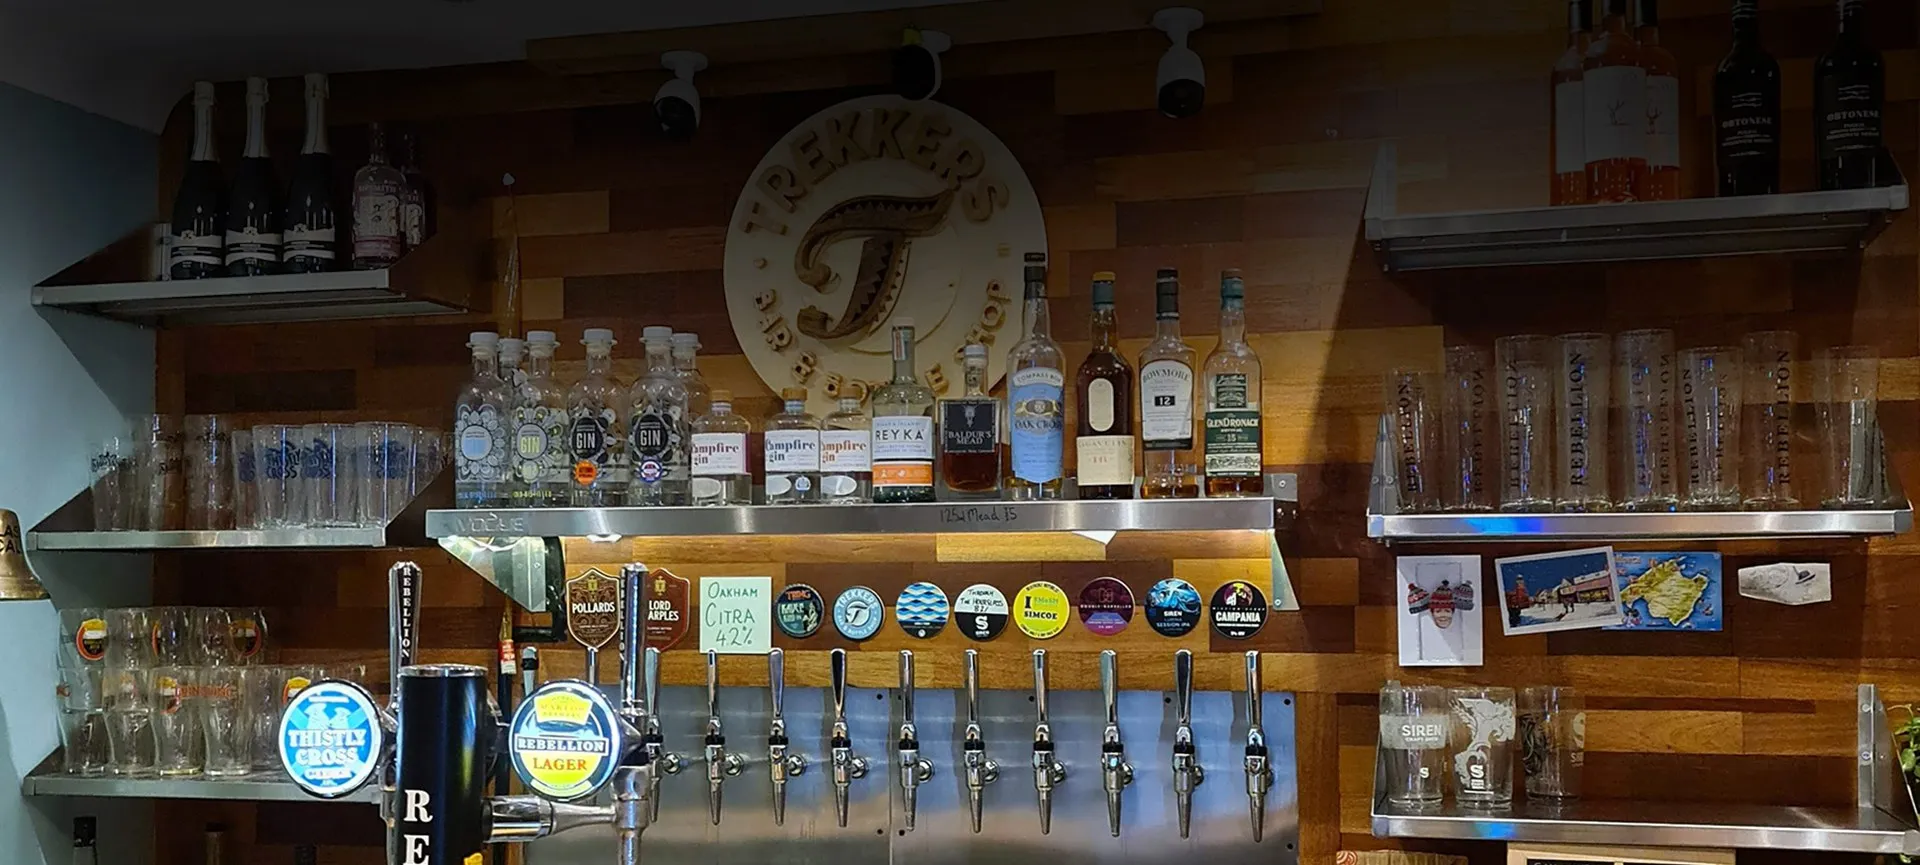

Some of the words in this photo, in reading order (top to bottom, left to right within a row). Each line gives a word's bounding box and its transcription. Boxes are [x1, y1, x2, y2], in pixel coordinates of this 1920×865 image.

[744, 106, 1009, 237] TREKKERS
[754, 286, 794, 352] BAR
[1159, 396, 1172, 406] 12
[1569, 352, 1583, 486] REBELLION
[576, 432, 596, 449] GIN
[640, 429, 661, 446] GIN
[876, 429, 924, 441] REYKA
[948, 430, 992, 440] BALDUR'S
[1227, 433, 1237, 442] 15
[520, 436, 541, 453] GIN
[648, 600, 671, 611] LORD
[836, 587, 880, 610] TREKKERS
[401, 566, 412, 659] REBELLION
[571, 602, 616, 614] POLLARDS
[647, 610, 680, 621] ARPLES
[975, 615, 989, 630] S
[1023, 611, 1058, 620] SIMCOE
[1215, 611, 1261, 623] CAMPANIA
[1401, 724, 1442, 737] SIREN
[287, 729, 367, 748] THISTLY
[516, 739, 605, 753] REBELLION
[294, 747, 359, 766] CROSS
[532, 758, 588, 771] LAGER
[1470, 764, 1485, 778] S
[1419, 766, 1429, 778] S
